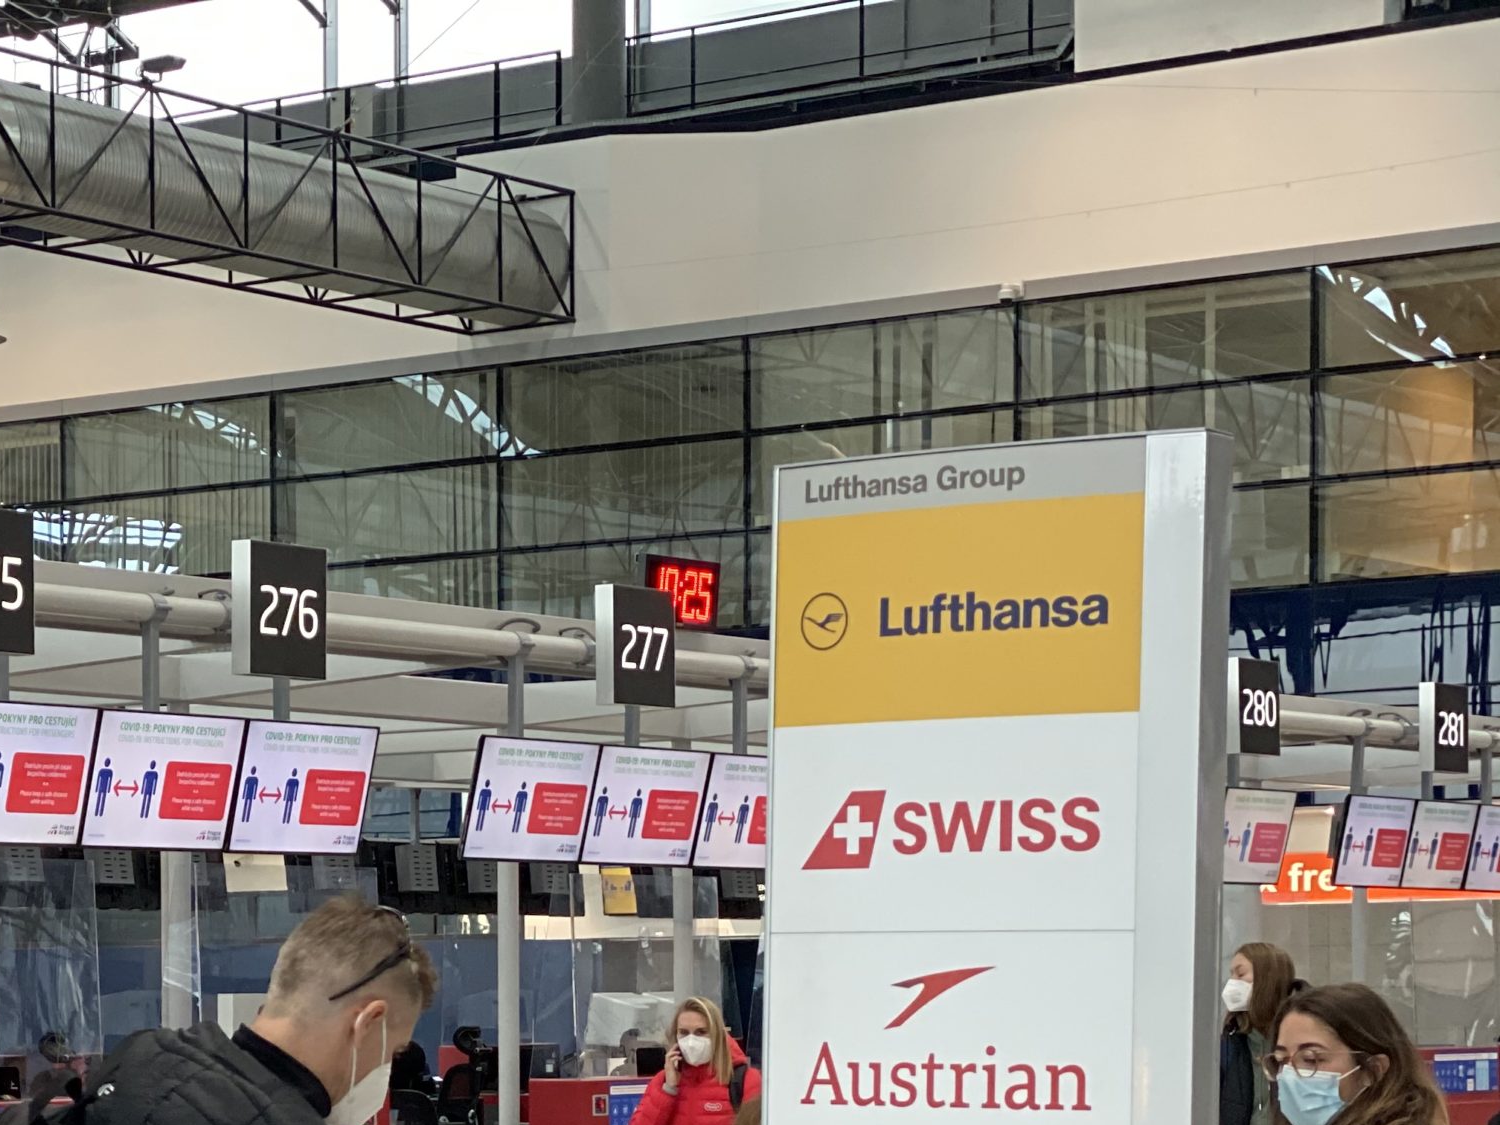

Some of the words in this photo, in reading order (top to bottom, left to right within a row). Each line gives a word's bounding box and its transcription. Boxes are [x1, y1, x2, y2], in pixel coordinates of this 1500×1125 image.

[804, 472, 928, 503] Lufthansa
[936, 464, 1025, 493] Group
[259, 584, 319, 639] 276
[879, 591, 1109, 637] Lufthansa
[621, 623, 669, 671] 277
[29, 715, 43, 725] PRO
[1242, 688, 1277, 727] 280
[1438, 711, 1464, 747] 281
[892, 797, 1101, 855] SWISS
[1287, 863, 1334, 891] fre
[800, 1041, 1092, 1112] Austrian
